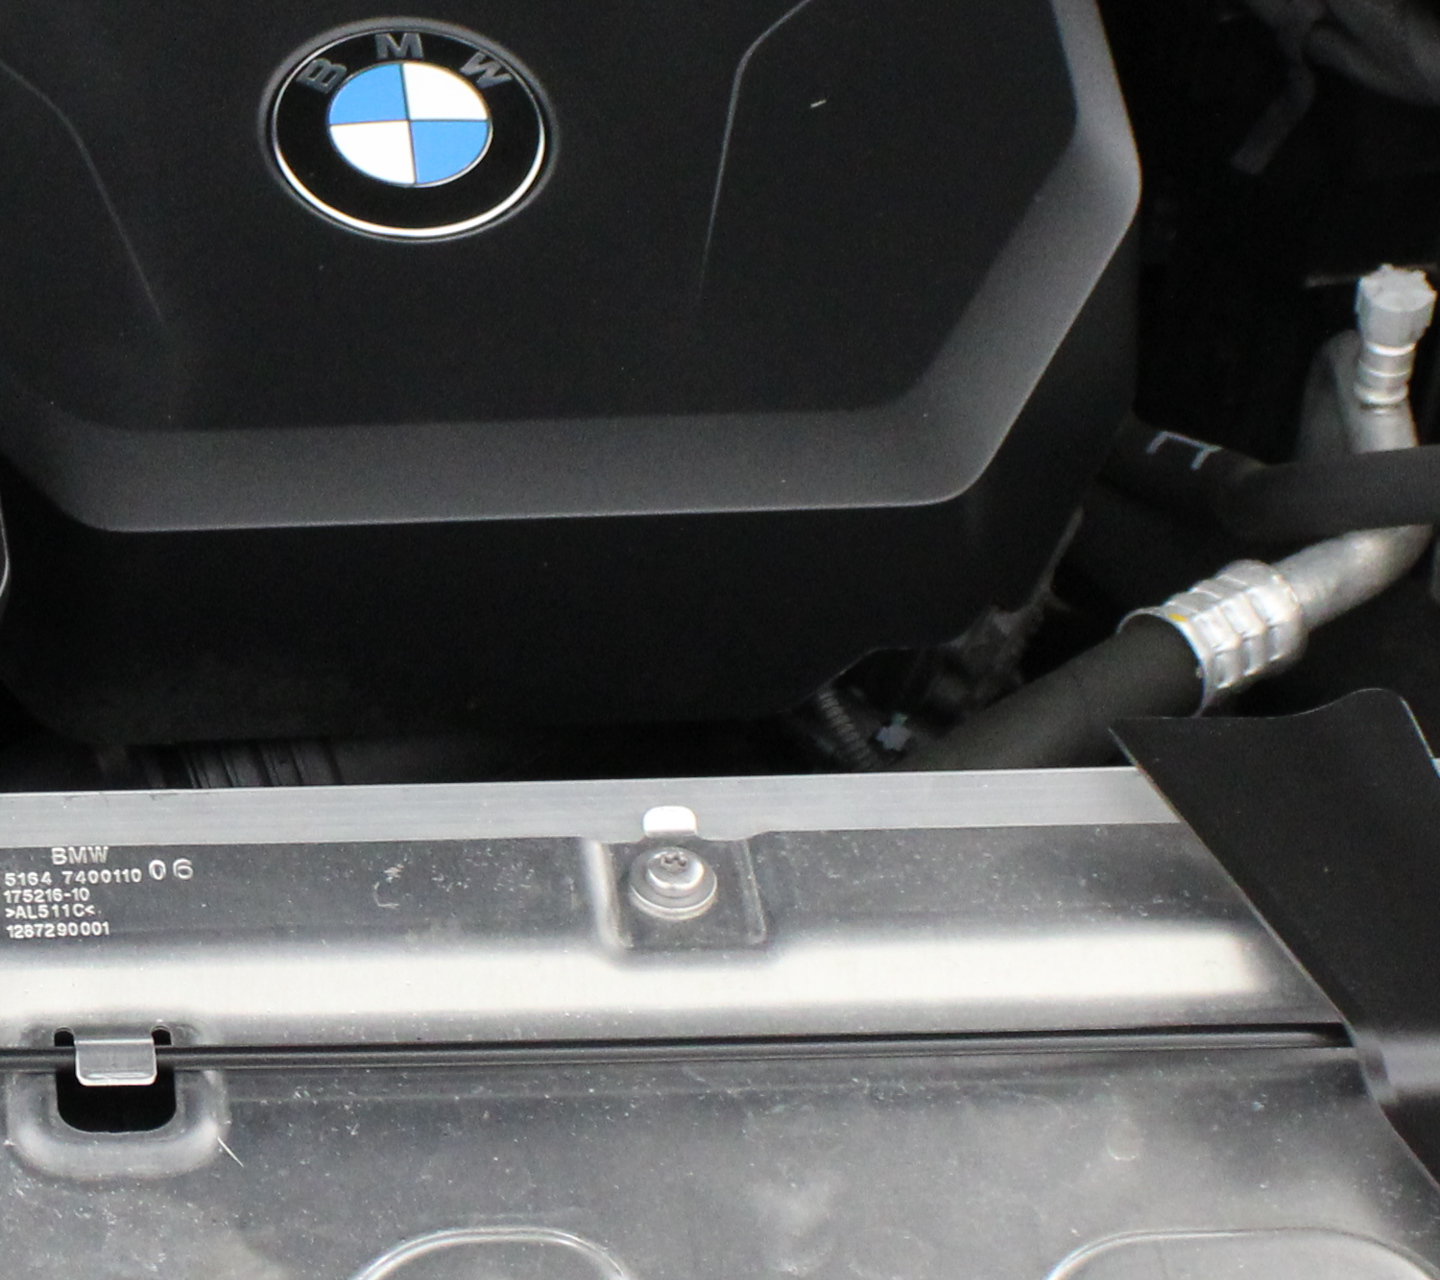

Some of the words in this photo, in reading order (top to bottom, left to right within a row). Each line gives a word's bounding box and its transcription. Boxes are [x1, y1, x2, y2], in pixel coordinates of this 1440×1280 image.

[296, 32, 513, 94] BMW
[51, 845, 110, 866] BMW
[4, 871, 53, 887] 5164
[62, 868, 142, 886] 7400110
[3, 887, 91, 904] 175216-10
